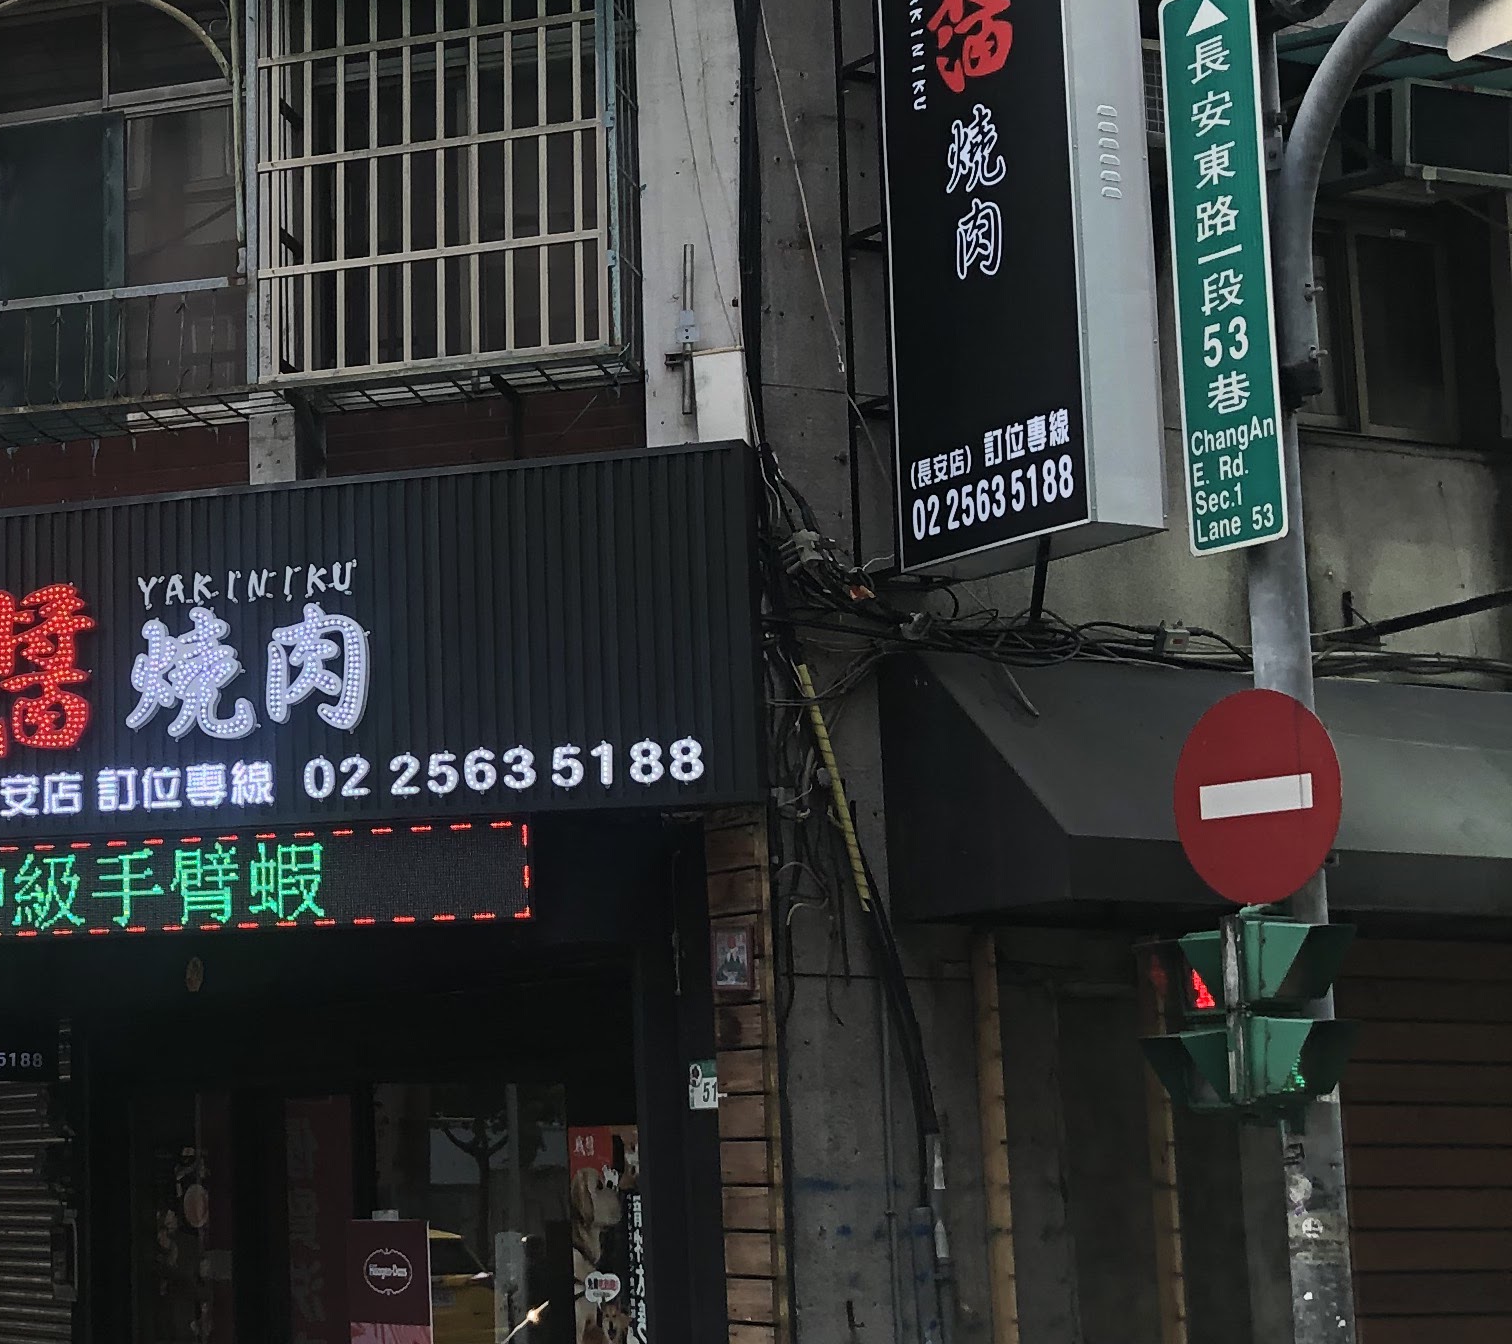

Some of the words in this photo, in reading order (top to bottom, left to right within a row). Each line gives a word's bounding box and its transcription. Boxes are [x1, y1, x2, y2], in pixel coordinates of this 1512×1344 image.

[983, 407, 1071, 467] 訂位專線
[1190, 417, 1275, 460] ChangAn
[1193, 462, 1210, 486] E.
[1220, 455, 1249, 480] Rd.
[912, 494, 942, 541] 02
[1195, 484, 1244, 513] Sec.1
[1197, 513, 1241, 544] Lane
[1252, 506, 1275, 529] 53
[138, 559, 357, 609] YAKINIKU
[97, 760, 275, 813] 訂位專線
[303, 754, 371, 800] 02
